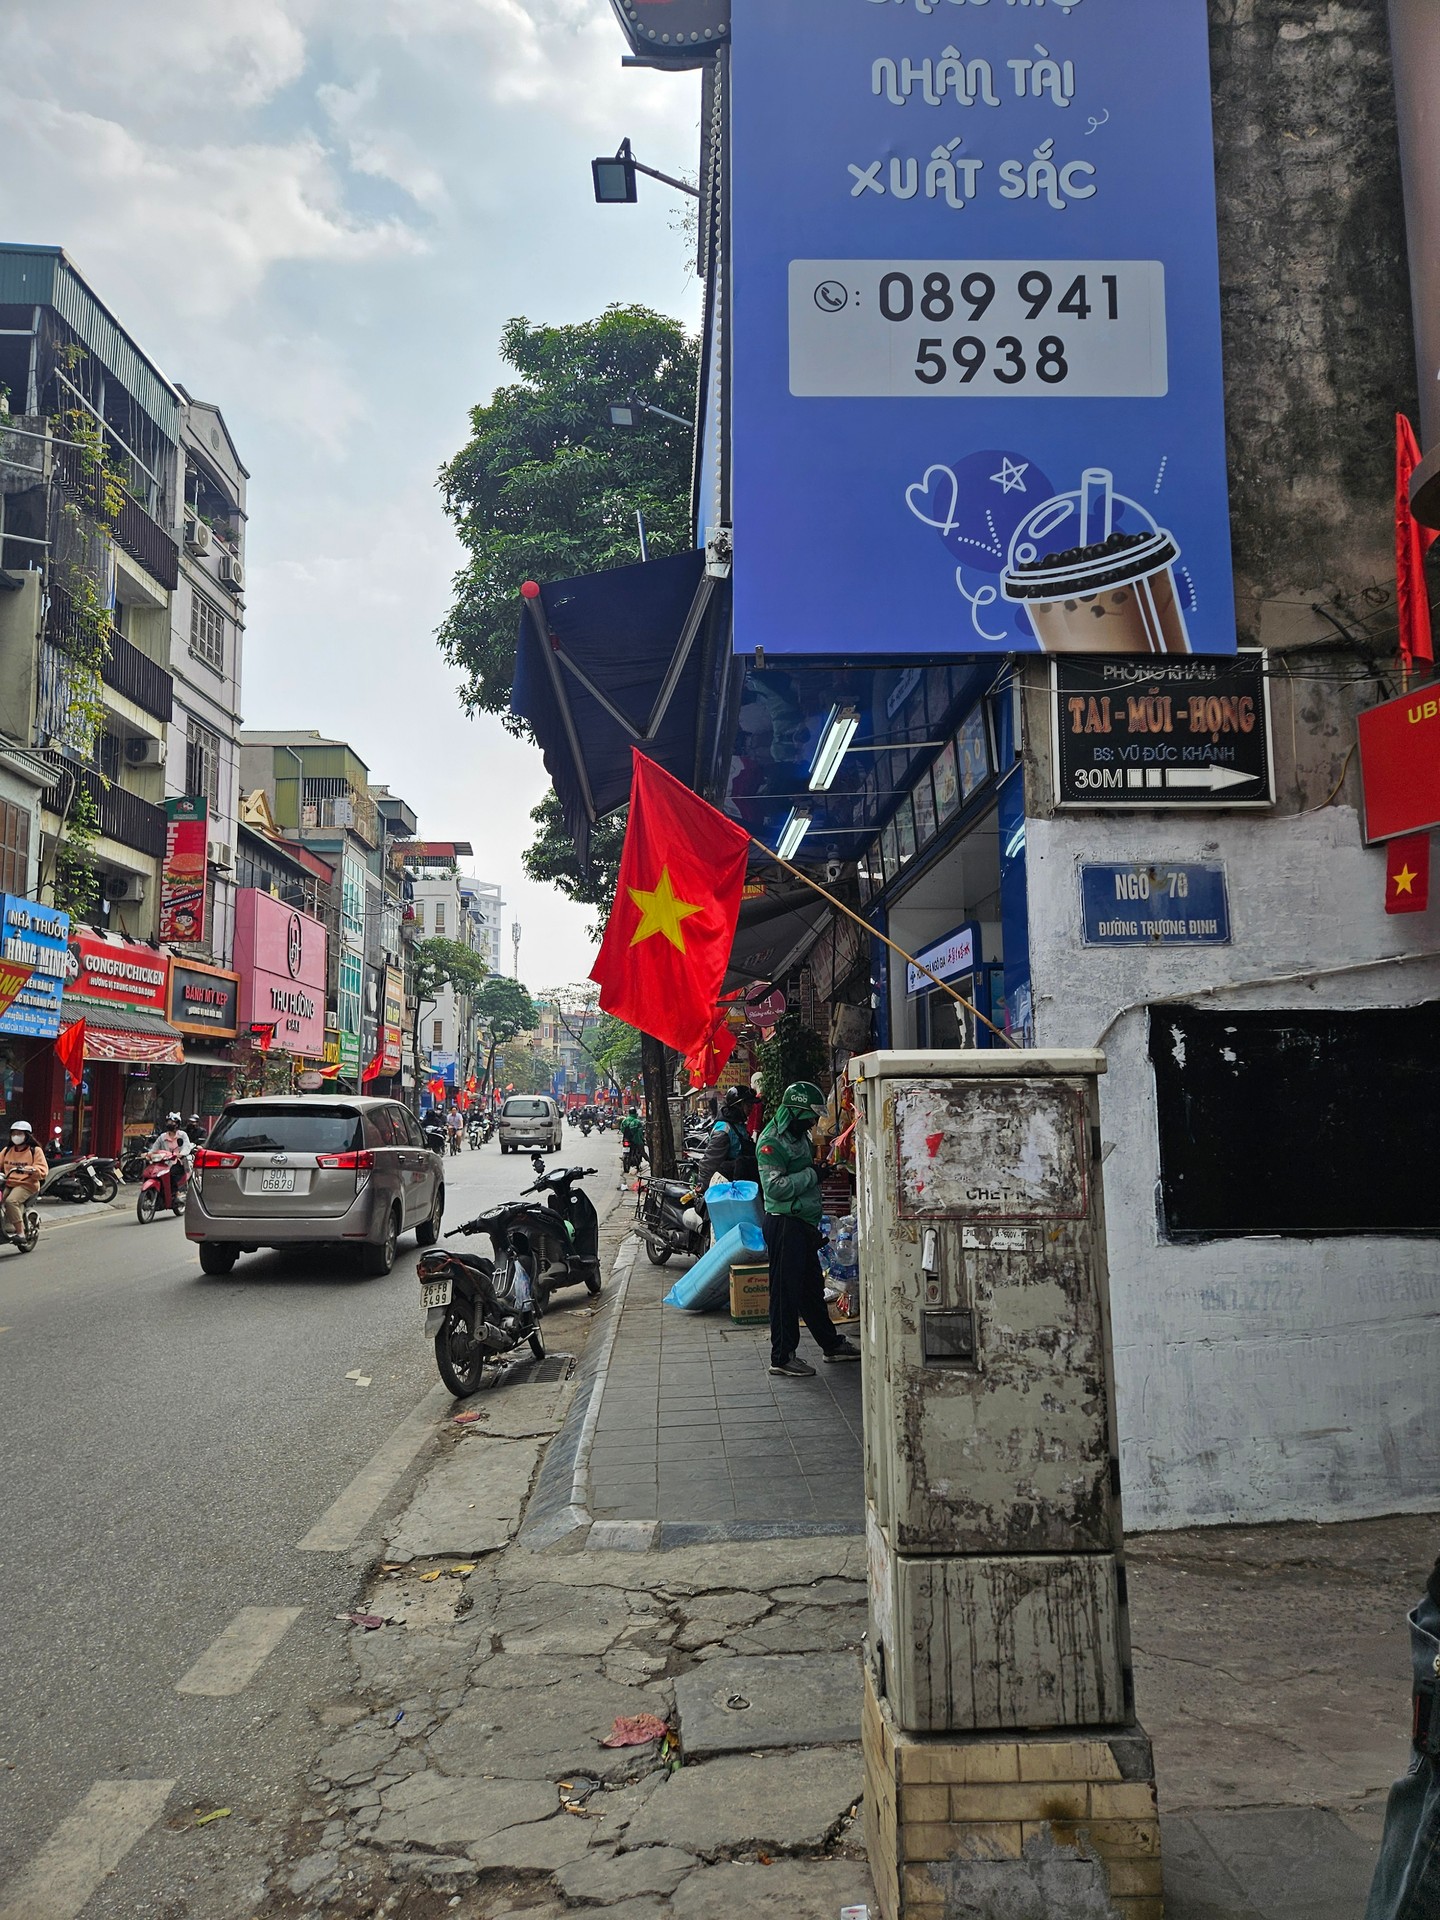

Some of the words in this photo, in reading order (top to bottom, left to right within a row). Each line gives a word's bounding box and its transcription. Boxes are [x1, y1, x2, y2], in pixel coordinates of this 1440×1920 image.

[871, 45, 1001, 107] NHÂN
[1007, 43, 1076, 108] TÀI
[847, 137, 985, 210] XUẤT
[999, 138, 1098, 210] SẮC
[878, 271, 996, 322] 089
[1017, 270, 1120, 321] 941
[914, 335, 1070, 385] 5938
[1408, 699, 1440, 724] UB
[1118, 743, 1141, 761] VŨ
[1143, 742, 1178, 762] ĐỨC
[1181, 742, 1236, 762] KHÁNH
[1074, 768, 1124, 789] 30M
[1115, 867, 1150, 900] NGÕ
[8, 909, 32, 931] NHÀ
[34, 915, 68, 940] THUỐC
[1098, 916, 1138, 936] ĐƯỜNG
[1140, 918, 1187, 936] TRƯƠNG
[1188, 918, 1218, 939] ĐỊNH
[6, 929, 37, 965] HỒNG
[39, 945, 67, 979] MINH
[84, 954, 126, 977] GONGFU
[126, 963, 165, 986] CHICKEN
[184, 984, 204, 1002] BÁNH
[271, 987, 289, 1012] THU
[790, 1093, 808, 1104] Grab
[270, 1169, 287, 1180] 90A
[423, 1293, 447, 1308] 5499
